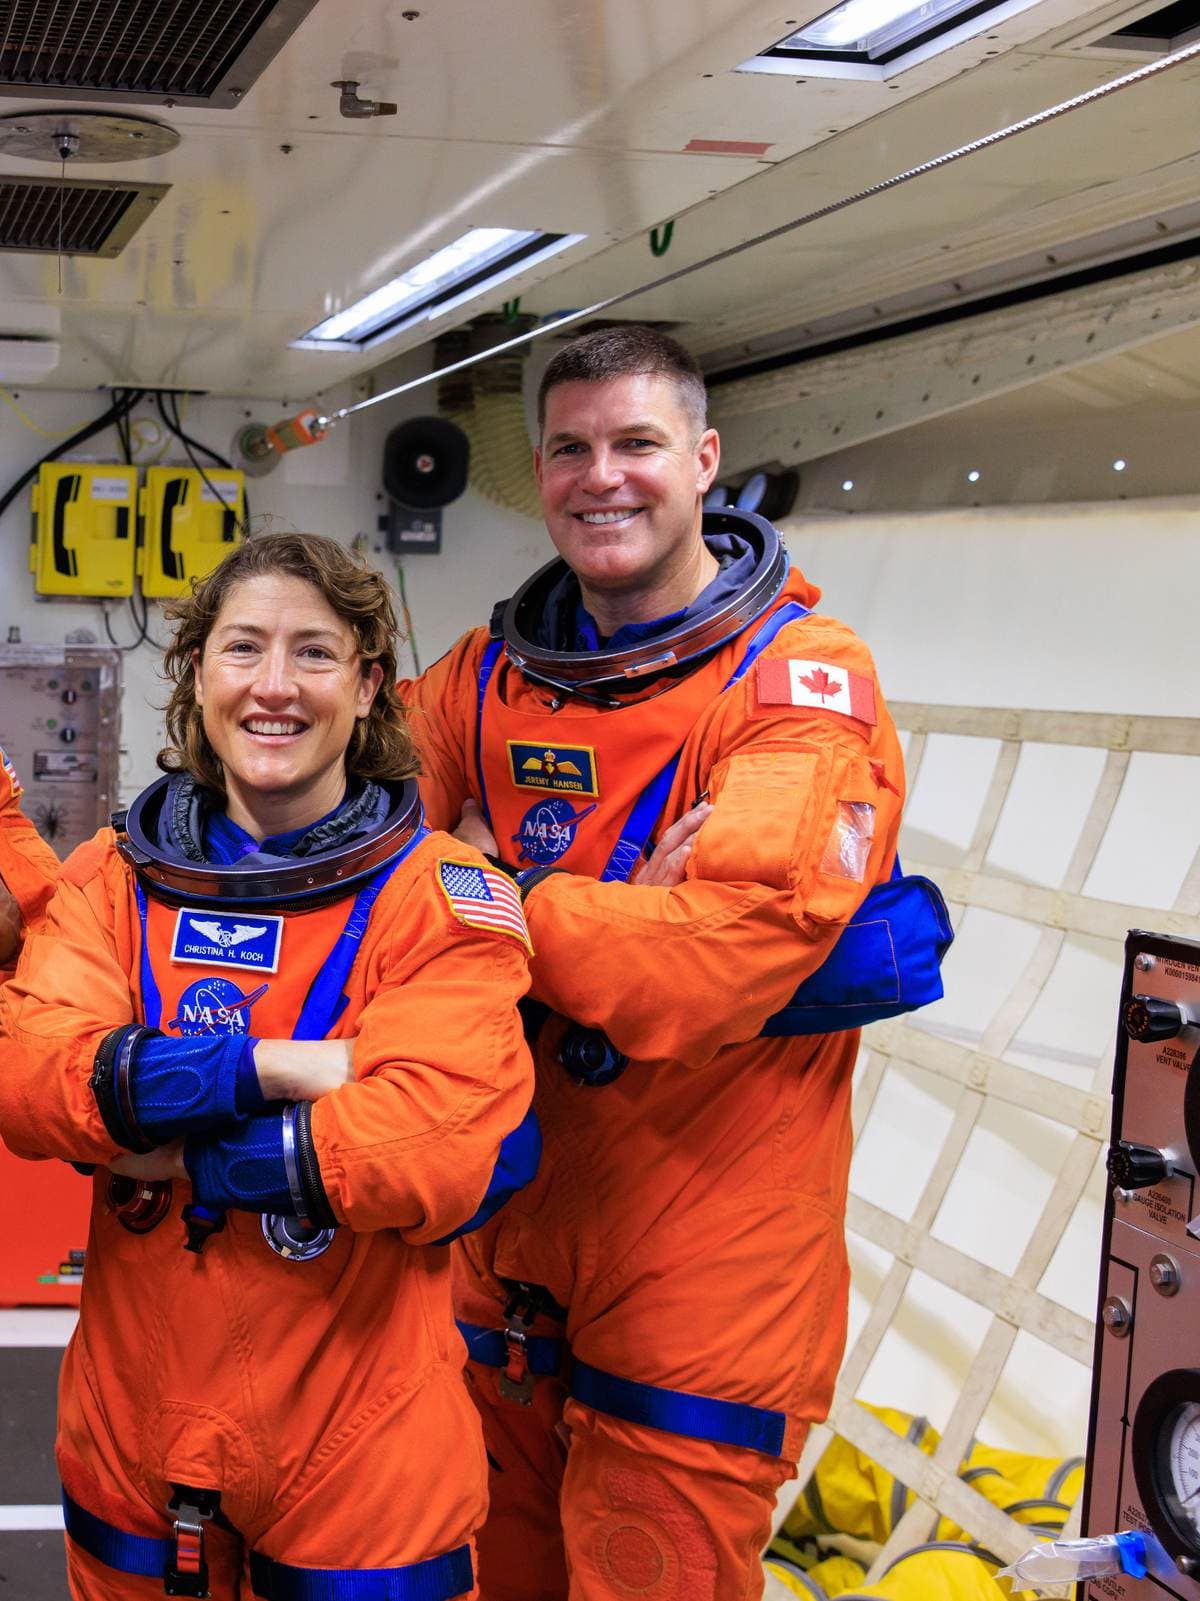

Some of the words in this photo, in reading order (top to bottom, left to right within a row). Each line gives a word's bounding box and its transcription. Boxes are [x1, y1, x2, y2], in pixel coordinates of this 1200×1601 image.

[525, 776, 550, 786] JEREMY
[553, 780, 583, 790] HANSEN
[524, 820, 571, 841] NASA
[184, 944, 224, 957] CHRISTINA
[240, 951, 264, 962] KOCH
[183, 1004, 246, 1027] NASA
[1156, 1054, 1172, 1066] VENT
[1133, 1193, 1154, 1208] GAUGE
[1154, 1202, 1186, 1222] ISOLATION
[1148, 1209, 1167, 1224] VALVE
[1123, 1511, 1137, 1526] TEST
